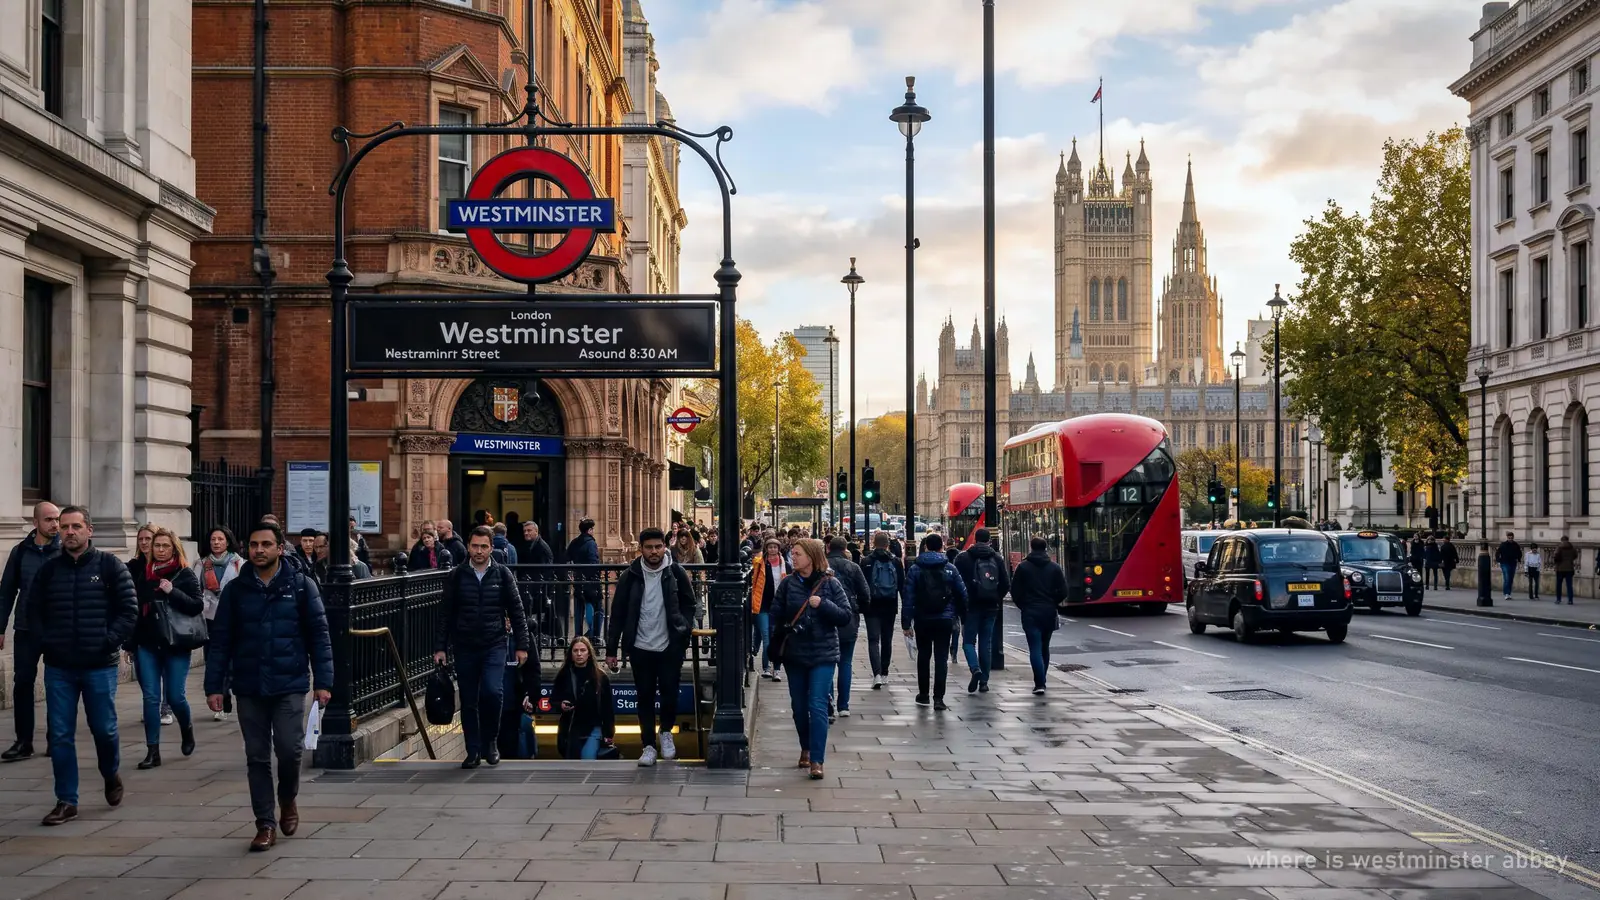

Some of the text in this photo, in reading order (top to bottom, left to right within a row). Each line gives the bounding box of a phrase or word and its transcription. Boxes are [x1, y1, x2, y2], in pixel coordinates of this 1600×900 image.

[458, 205, 603, 223] WESTMINSTER
[511, 310, 552, 321] London
[439, 322, 623, 345] Westminster
[461, 348, 501, 360] Street
[578, 347, 678, 360] Asound 8:30 AM
[473, 439, 541, 451] WESTMINSTER
[1121, 487, 1138, 502] 12
